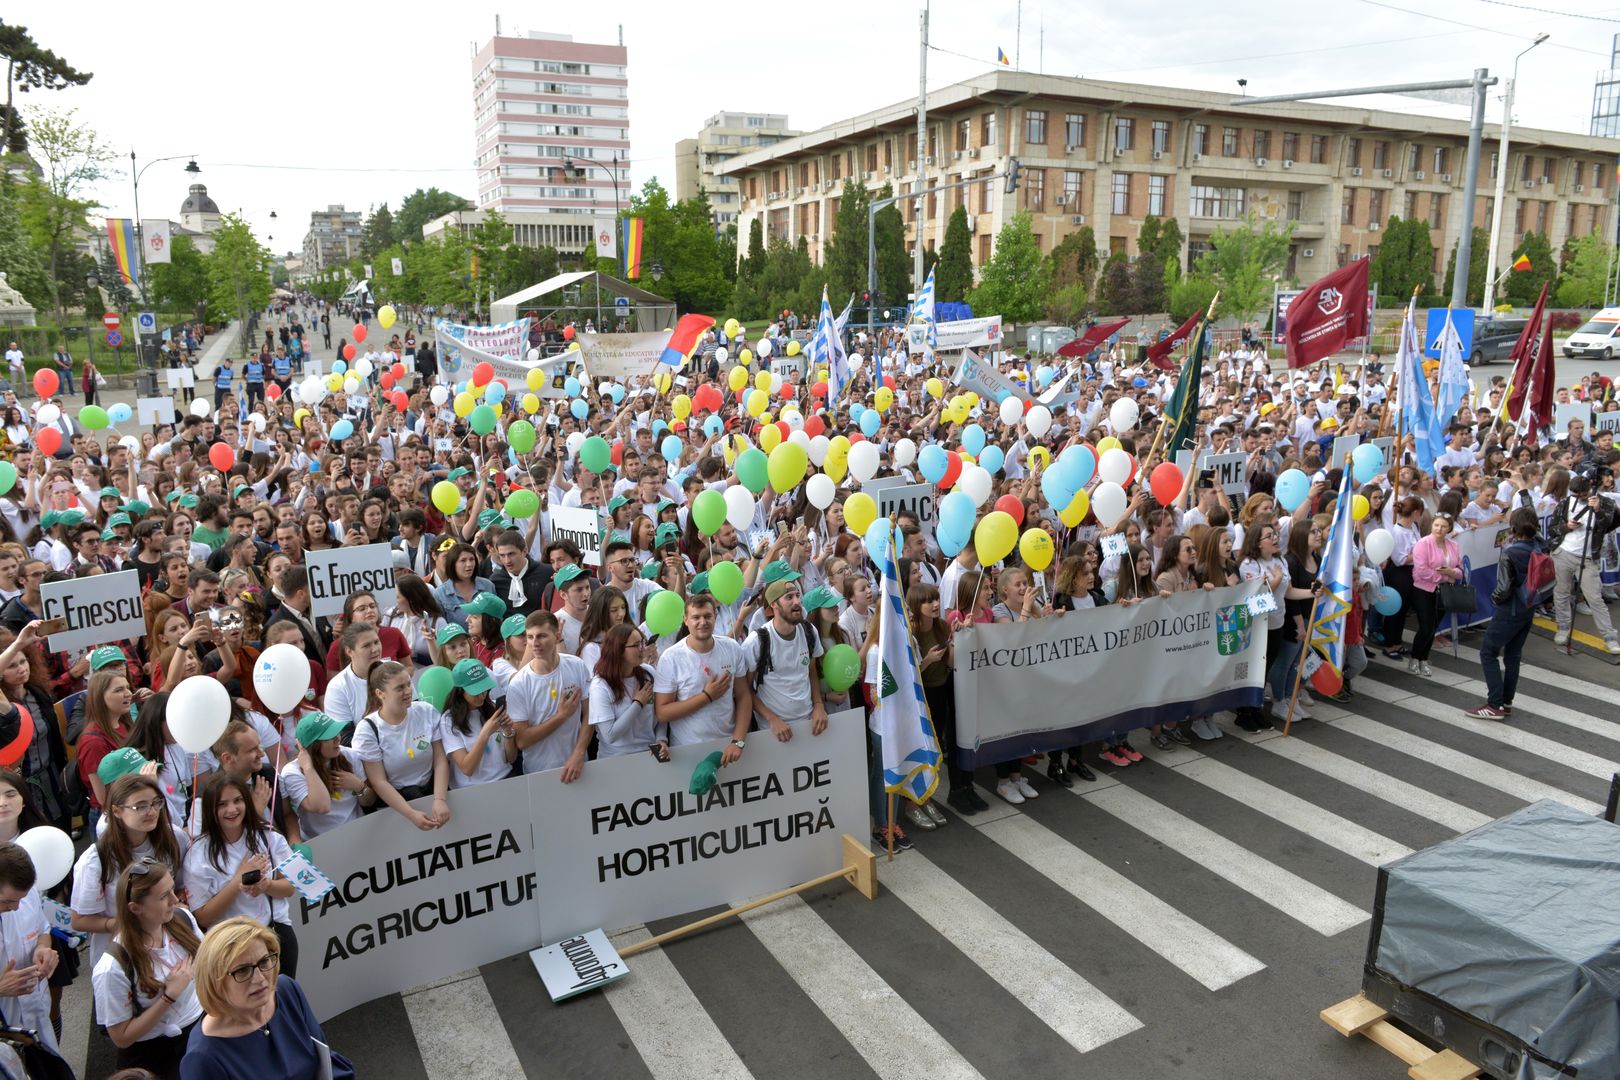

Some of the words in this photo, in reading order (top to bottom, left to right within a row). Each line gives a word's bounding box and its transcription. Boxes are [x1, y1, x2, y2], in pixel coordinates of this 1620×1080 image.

[977, 369, 1001, 393] FACUL
[1211, 461, 1243, 485] M.F.
[881, 495, 932, 524] UAIC
[969, 634, 1098, 671] FACULTATEA
[1103, 628, 1130, 651] DE
[1133, 610, 1211, 644] BIOLOGIE
[792, 759, 832, 793] DE
[597, 796, 836, 883] HORTICULTURĂ
[299, 828, 522, 925] FACULTATEA
